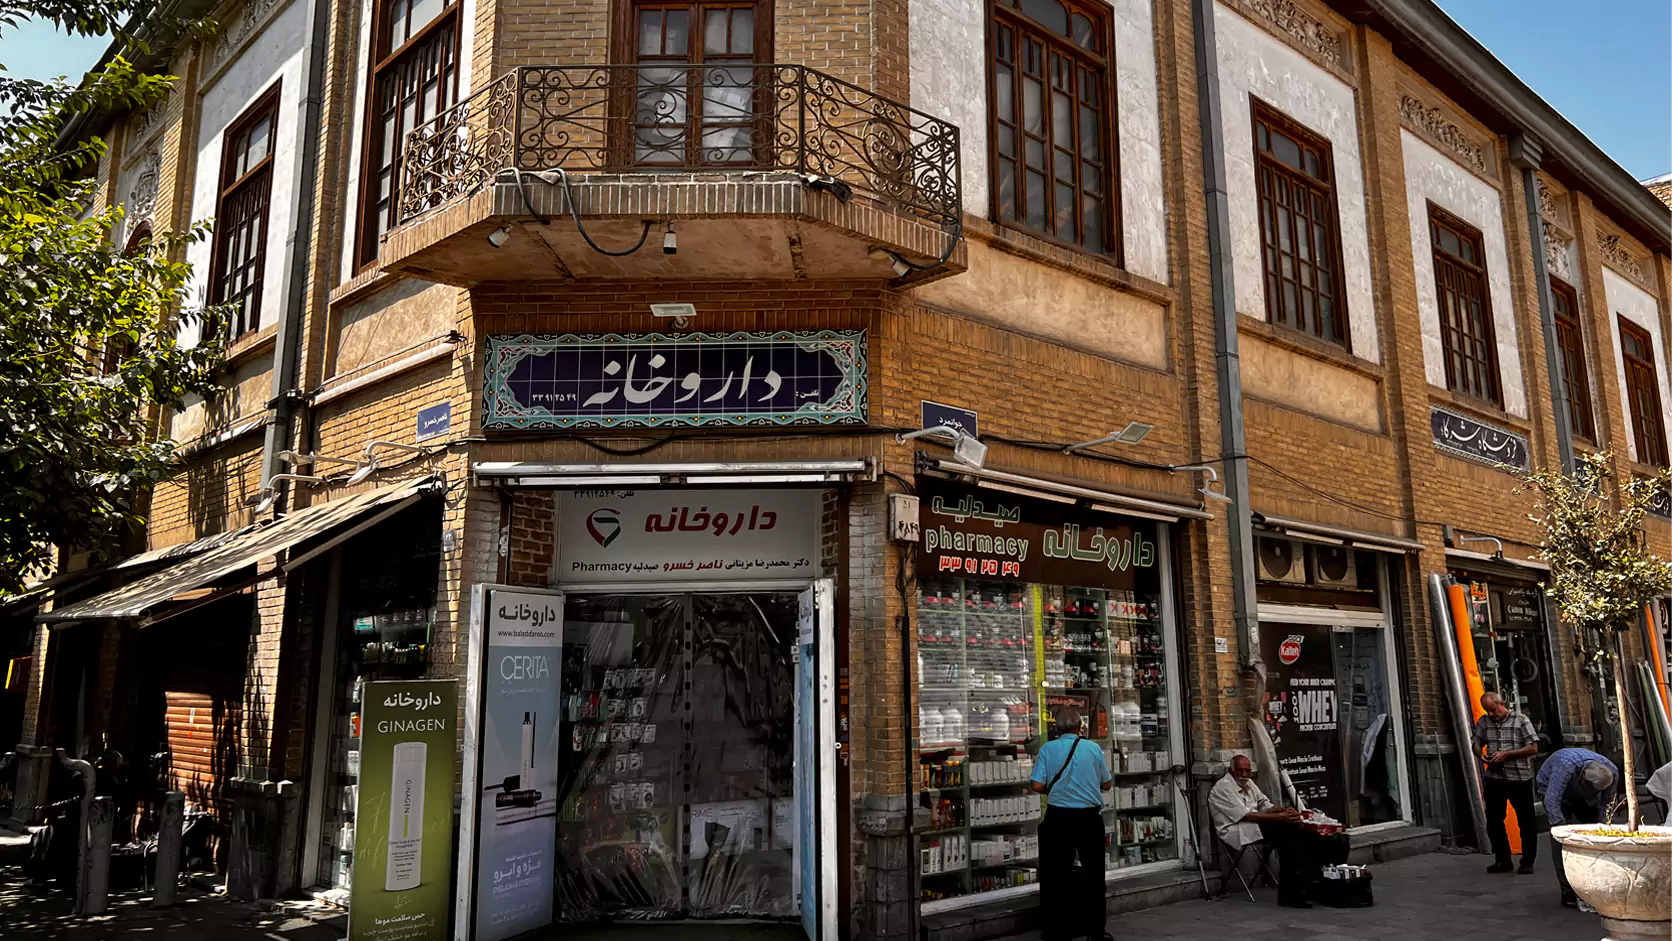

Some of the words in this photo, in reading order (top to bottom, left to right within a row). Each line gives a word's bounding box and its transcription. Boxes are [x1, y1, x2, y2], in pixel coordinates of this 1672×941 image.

[583, 353, 782, 407] داروخانه
[644, 505, 778, 537] داروخانه
[925, 524, 1029, 562] pharmacy
[1043, 523, 1155, 572] داروخانه
[572, 561, 632, 573] Pharmacy
[663, 559, 694, 572] خسرو
[696, 559, 723, 572] ناصر
[792, 558, 810, 570] دکتر
[499, 603, 556, 627] داروخانه
[497, 629, 556, 638] www.baladdaroo.com
[500, 655, 549, 680] CERITA
[383, 692, 442, 711] داروخانه
[1298, 690, 1338, 724] WHEY
[377, 718, 445, 733] GINAGEN
[404, 780, 412, 813] GINAGEN
[493, 862, 515, 884] ابرو
[516, 865, 521, 878] و
[523, 857, 542, 875] مژه
[375, 918, 390, 926] موها
[390, 913, 411, 922] سلامت
